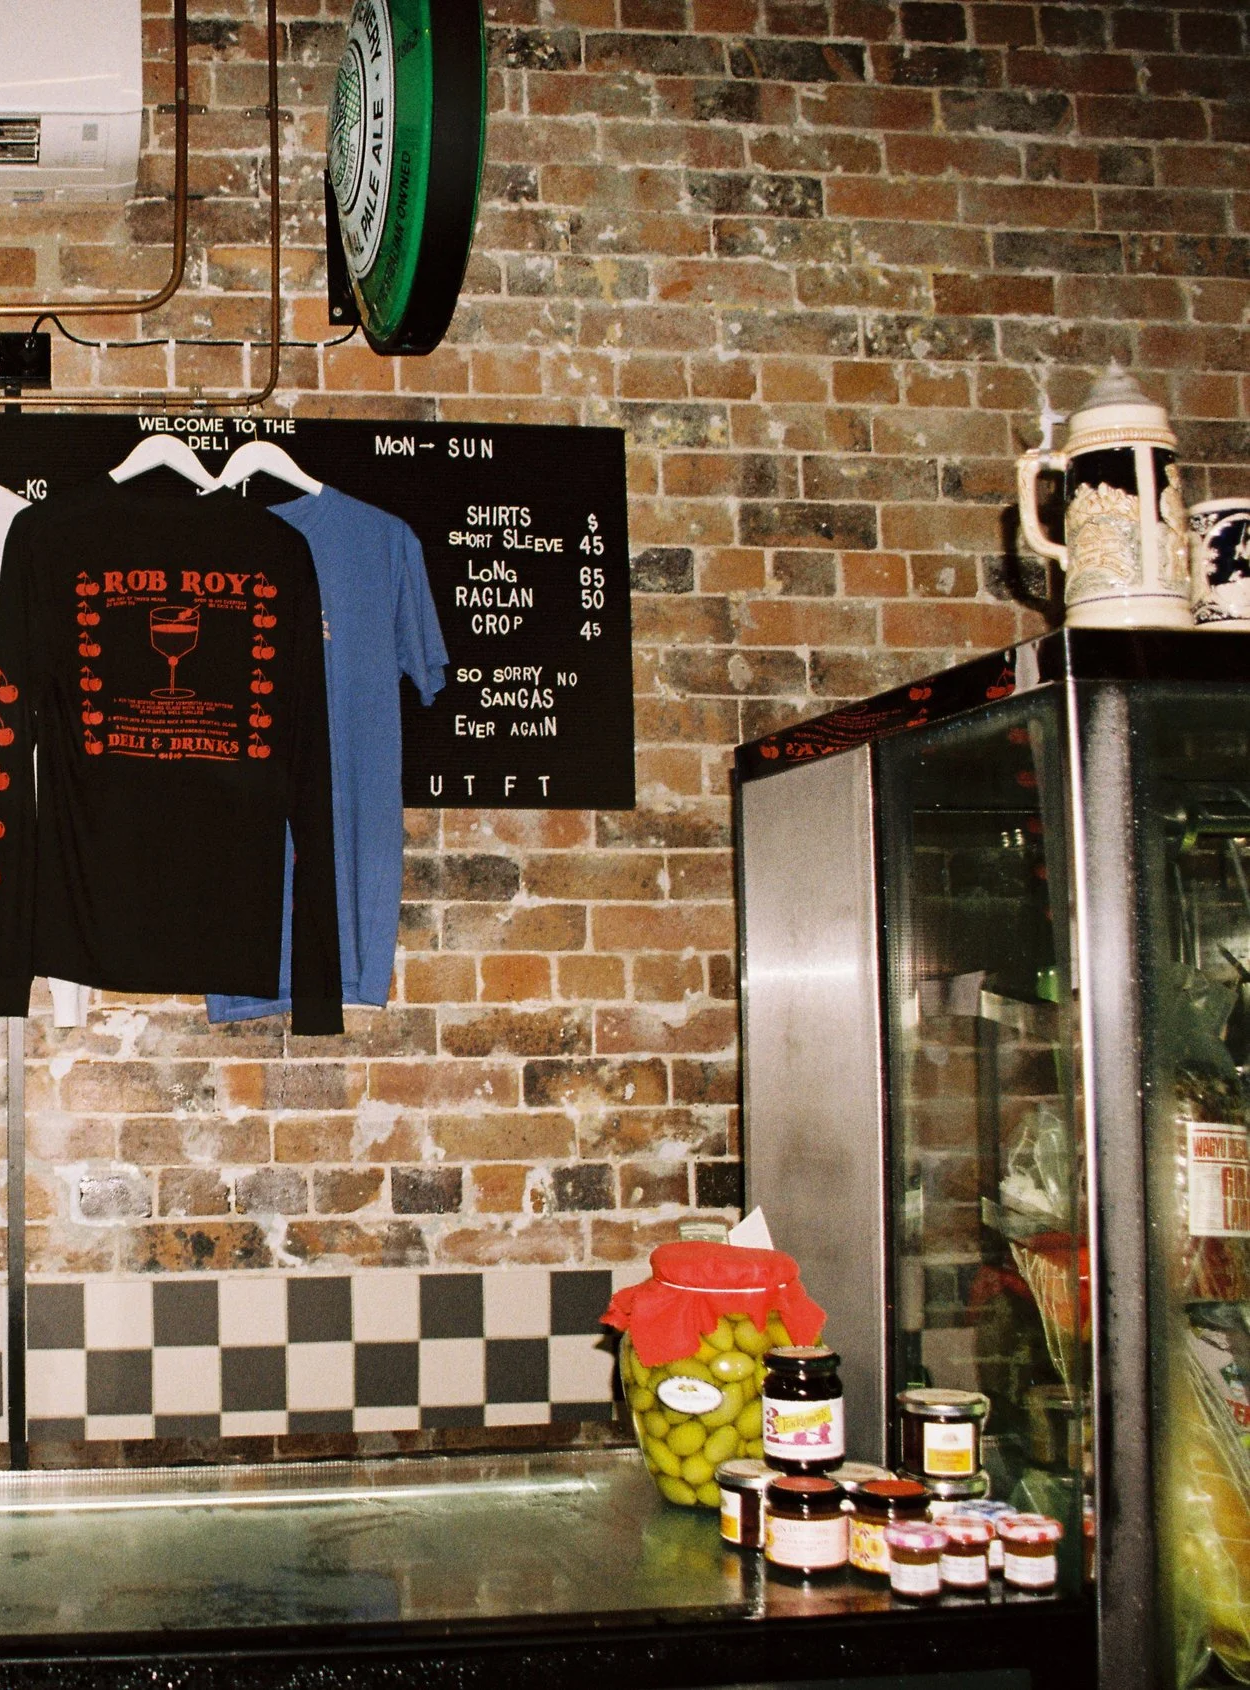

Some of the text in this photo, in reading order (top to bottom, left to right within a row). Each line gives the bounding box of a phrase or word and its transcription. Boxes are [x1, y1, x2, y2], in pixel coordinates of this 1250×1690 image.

[360, 97, 384, 242] PALE ALE
[397, 151, 412, 220] OWNED
[138, 416, 296, 434] WELCOME TO THE
[187, 435, 229, 451] DELI
[447, 437, 494, 460] SUN
[466, 505, 599, 534] SHIRTS $
[448, 528, 605, 556] SHORT SLEEVE 45
[102, 570, 251, 597] ROB ROY
[579, 565, 605, 589] 65
[455, 585, 605, 610] RAGLAN 50
[471, 613, 602, 642] CROP 45
[456, 665, 578, 688] SO SORRY NO
[480, 687, 554, 710] SANGAS
[454, 714, 558, 739] EVER AGAIN
[107, 733, 240, 755] DELI & DRINKS
